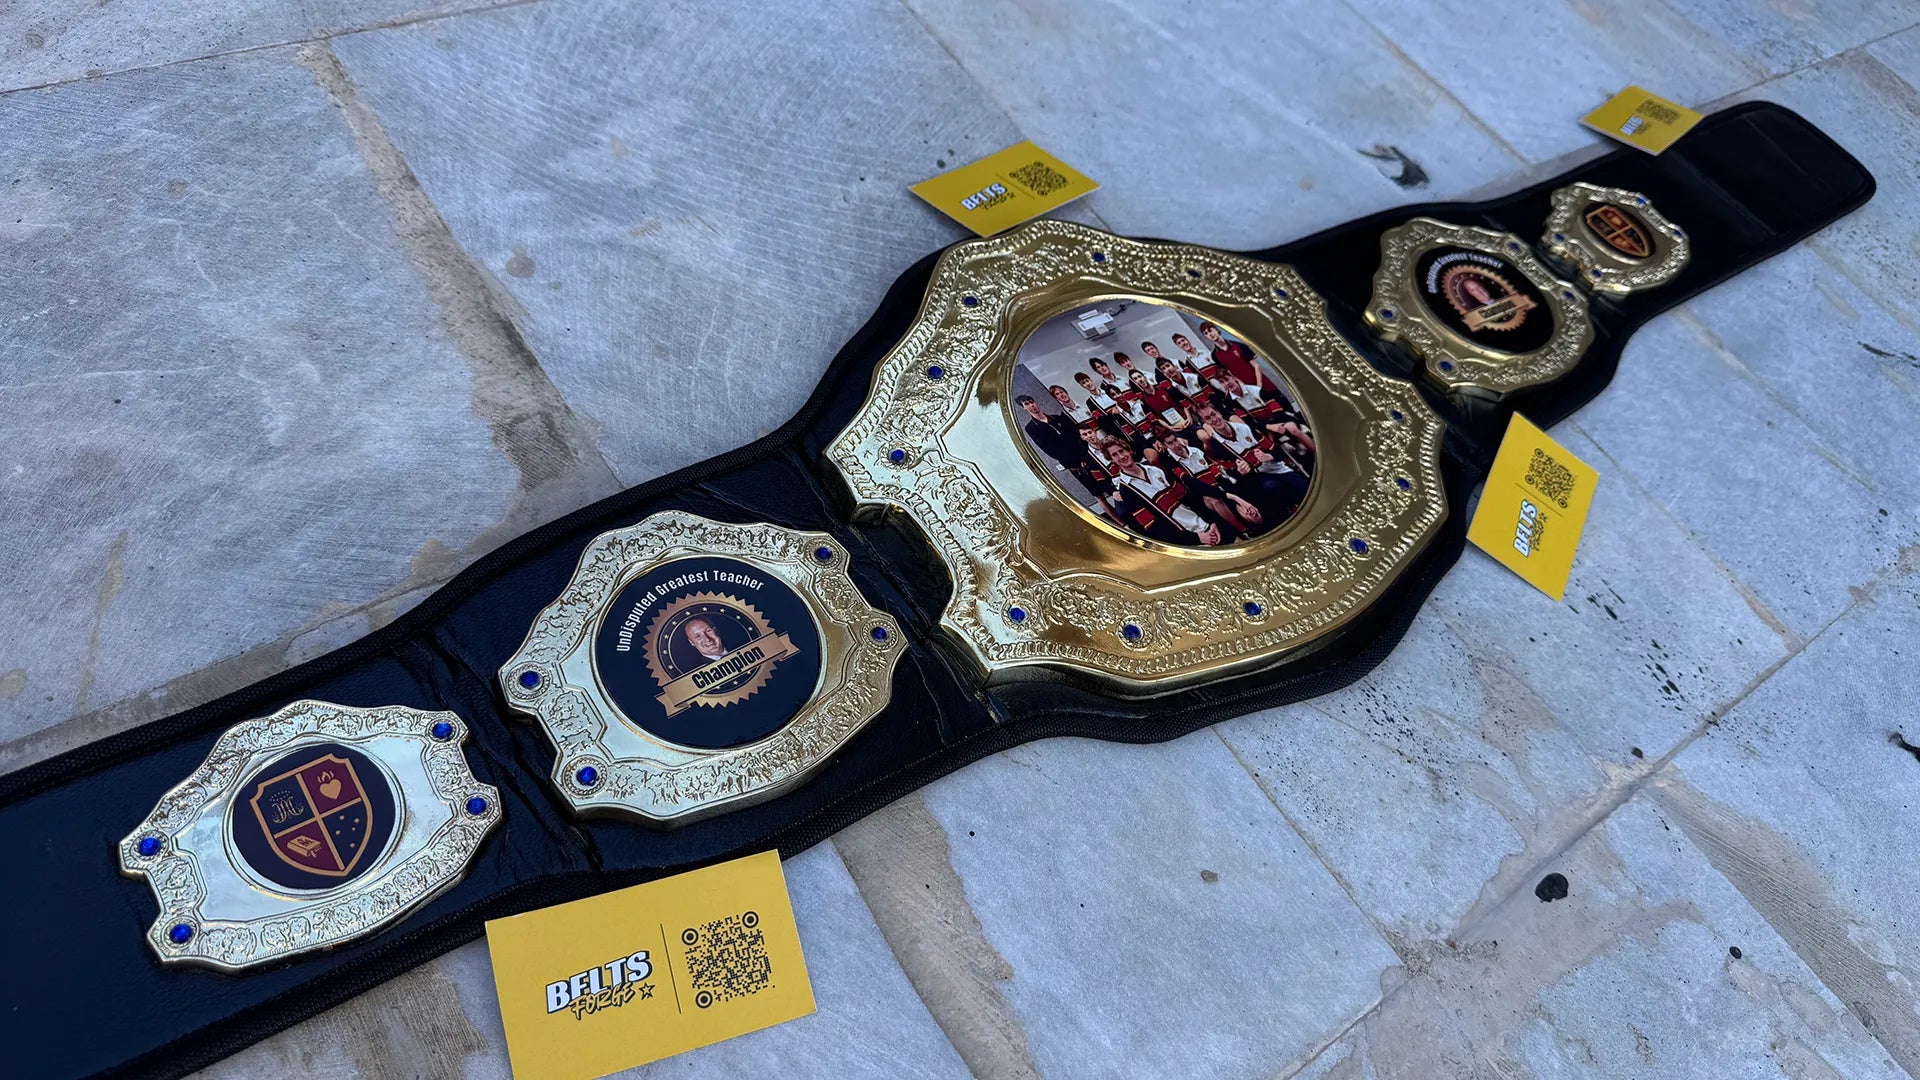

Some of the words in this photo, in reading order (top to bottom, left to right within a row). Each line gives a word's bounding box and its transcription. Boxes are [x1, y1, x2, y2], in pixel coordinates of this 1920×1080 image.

[616, 591, 658, 652] UnDisputed
[655, 570, 709, 596] Greatest
[713, 570, 765, 591] Teacher
[691, 646, 766, 689] Champion
[568, 981, 636, 1021] FORGE
